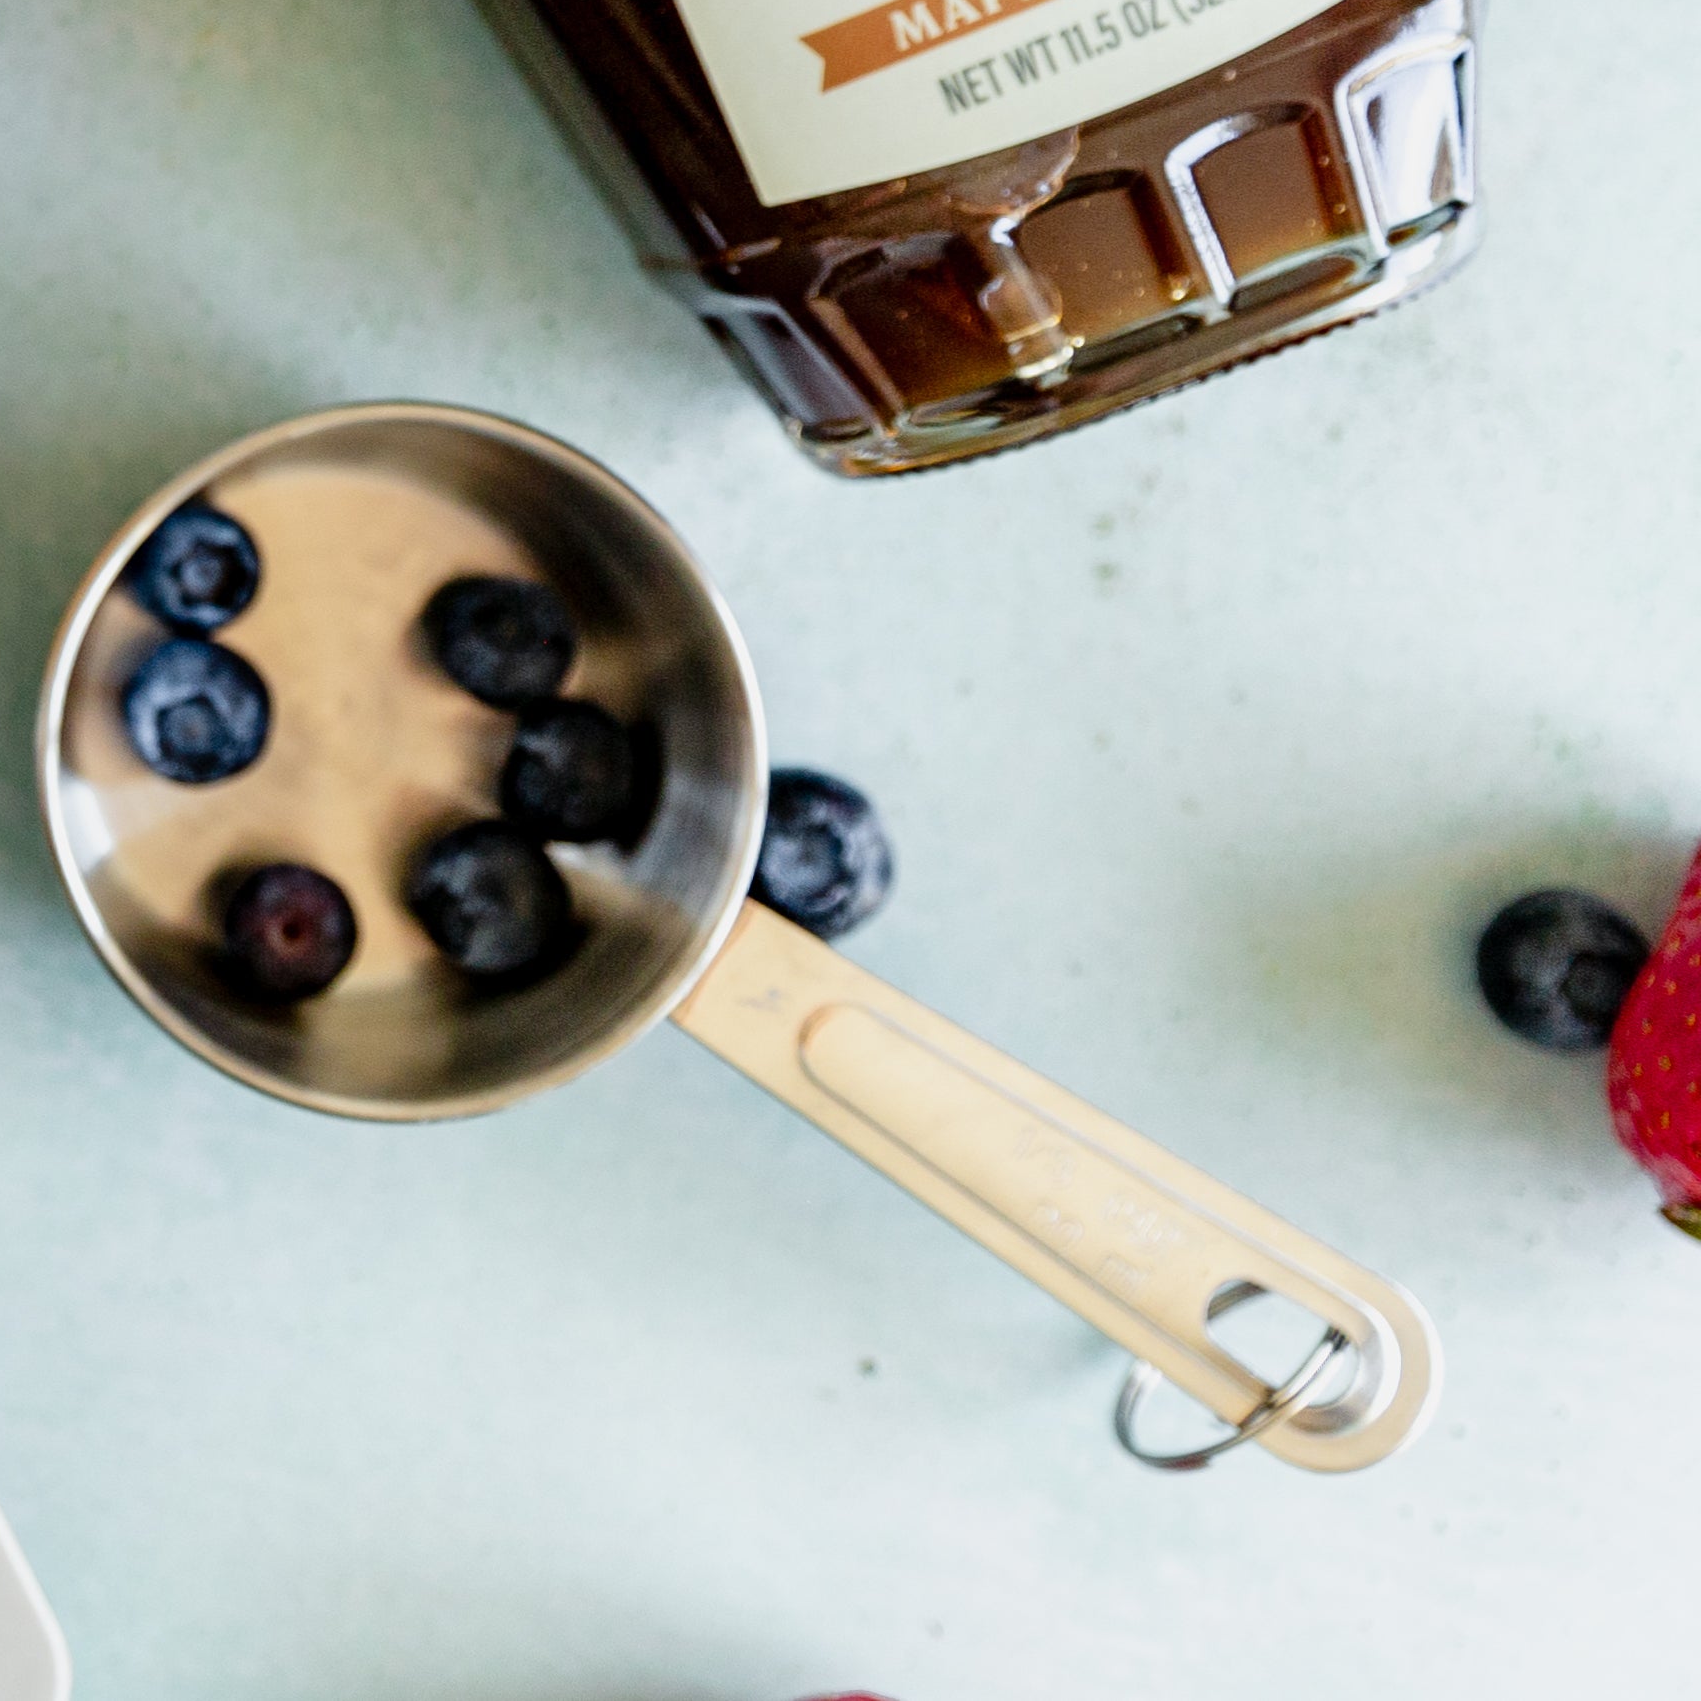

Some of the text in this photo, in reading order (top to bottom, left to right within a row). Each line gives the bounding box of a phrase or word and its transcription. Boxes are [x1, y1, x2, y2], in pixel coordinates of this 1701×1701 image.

[938, 58, 1001, 116] NET
[1004, 34, 1060, 88] WT
[1059, 9, 1123, 65] 11.5
